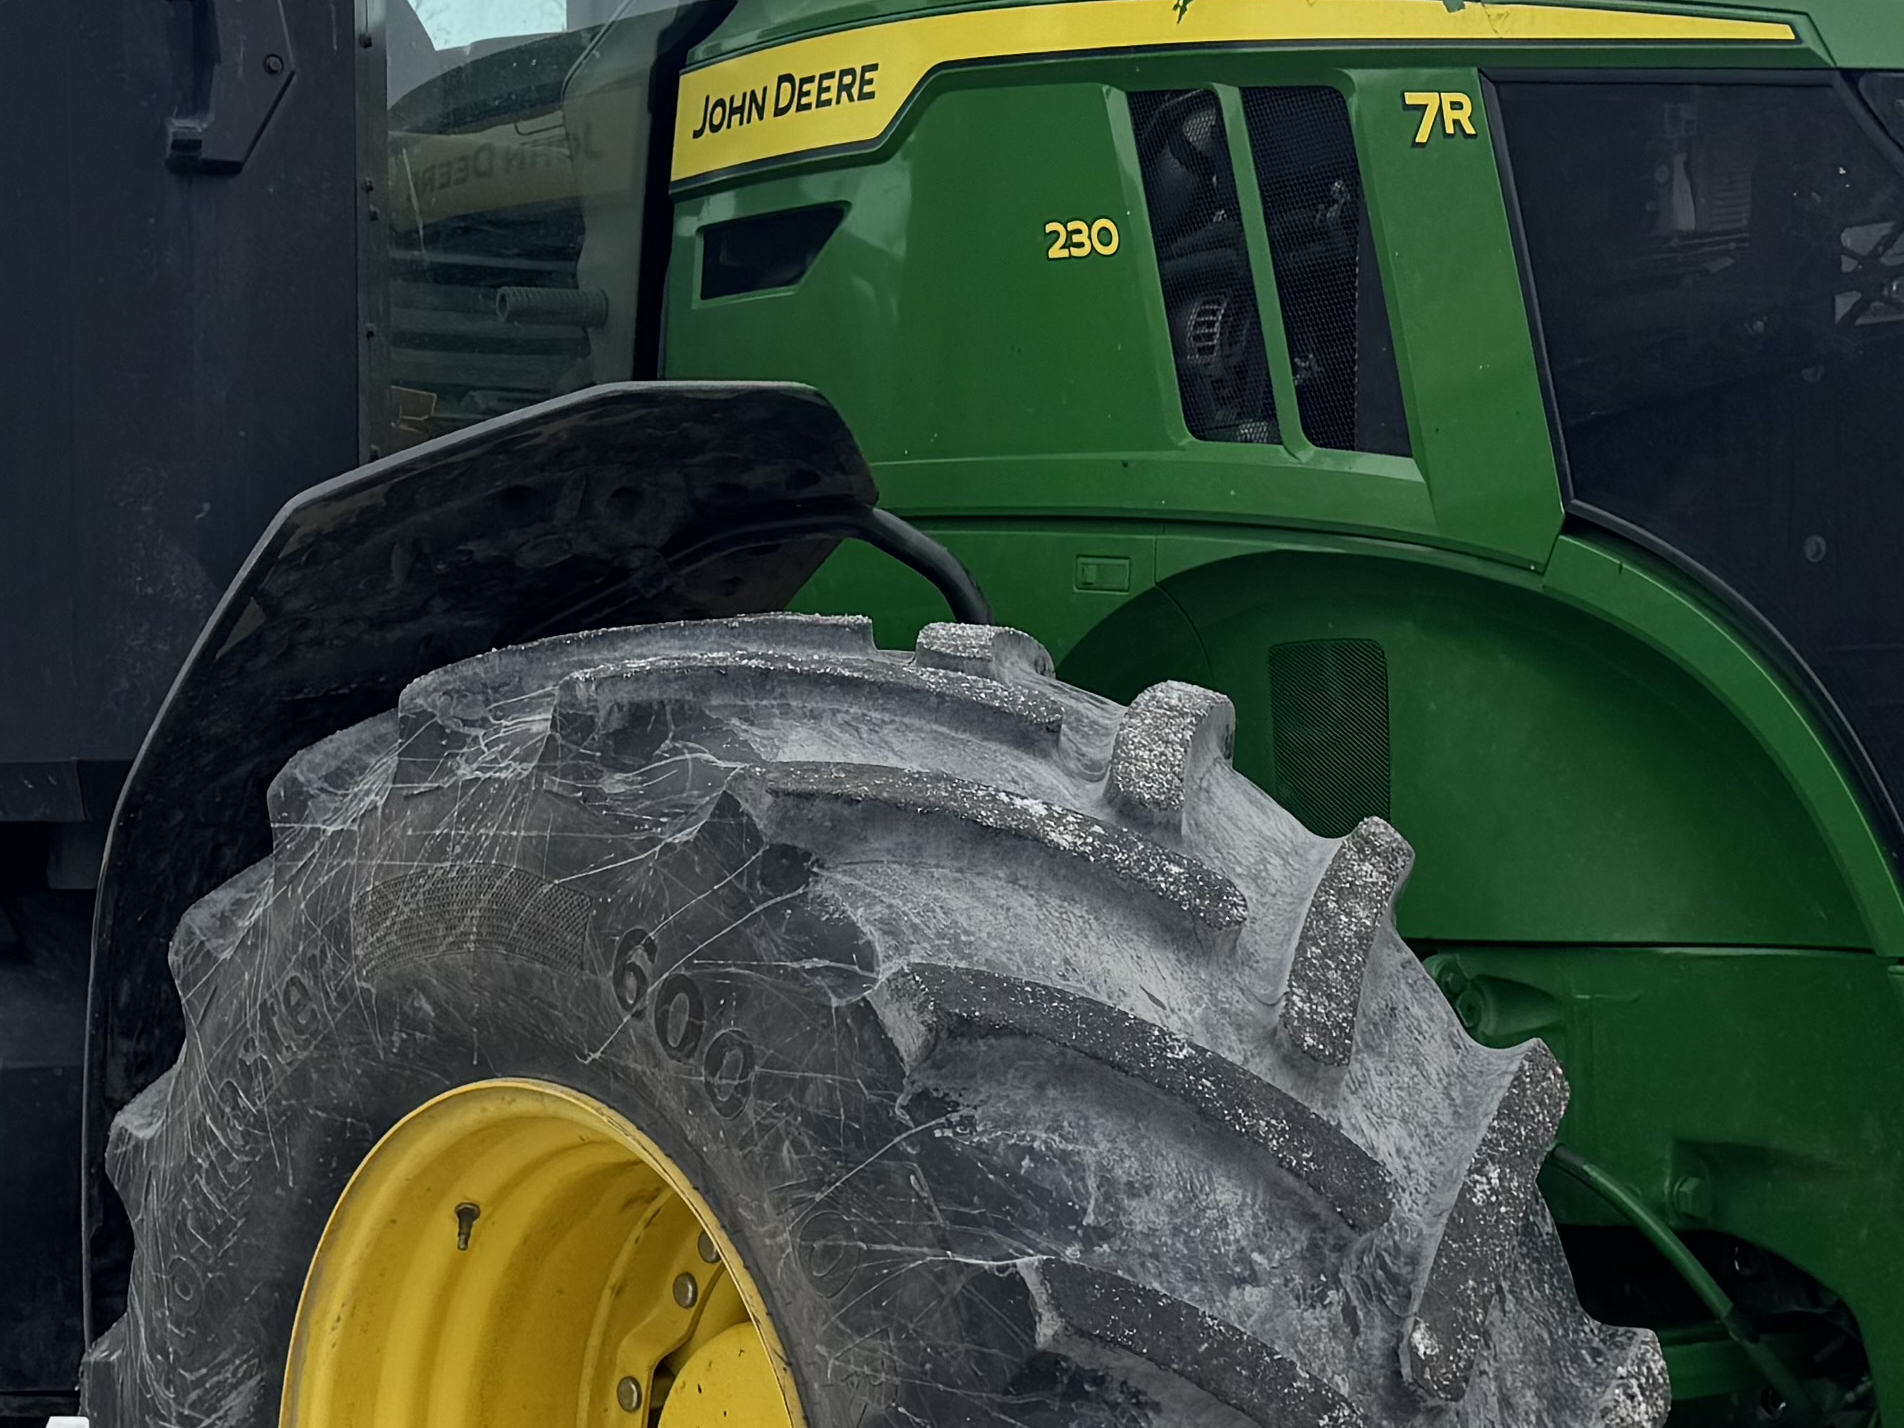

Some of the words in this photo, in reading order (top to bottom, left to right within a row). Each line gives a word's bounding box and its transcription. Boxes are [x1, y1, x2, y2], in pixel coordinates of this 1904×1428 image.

[692, 85, 768, 139] JOHN
[773, 62, 879, 118] DEERE
[1403, 91, 1477, 144] 7R
[1044, 217, 1120, 259] 230
